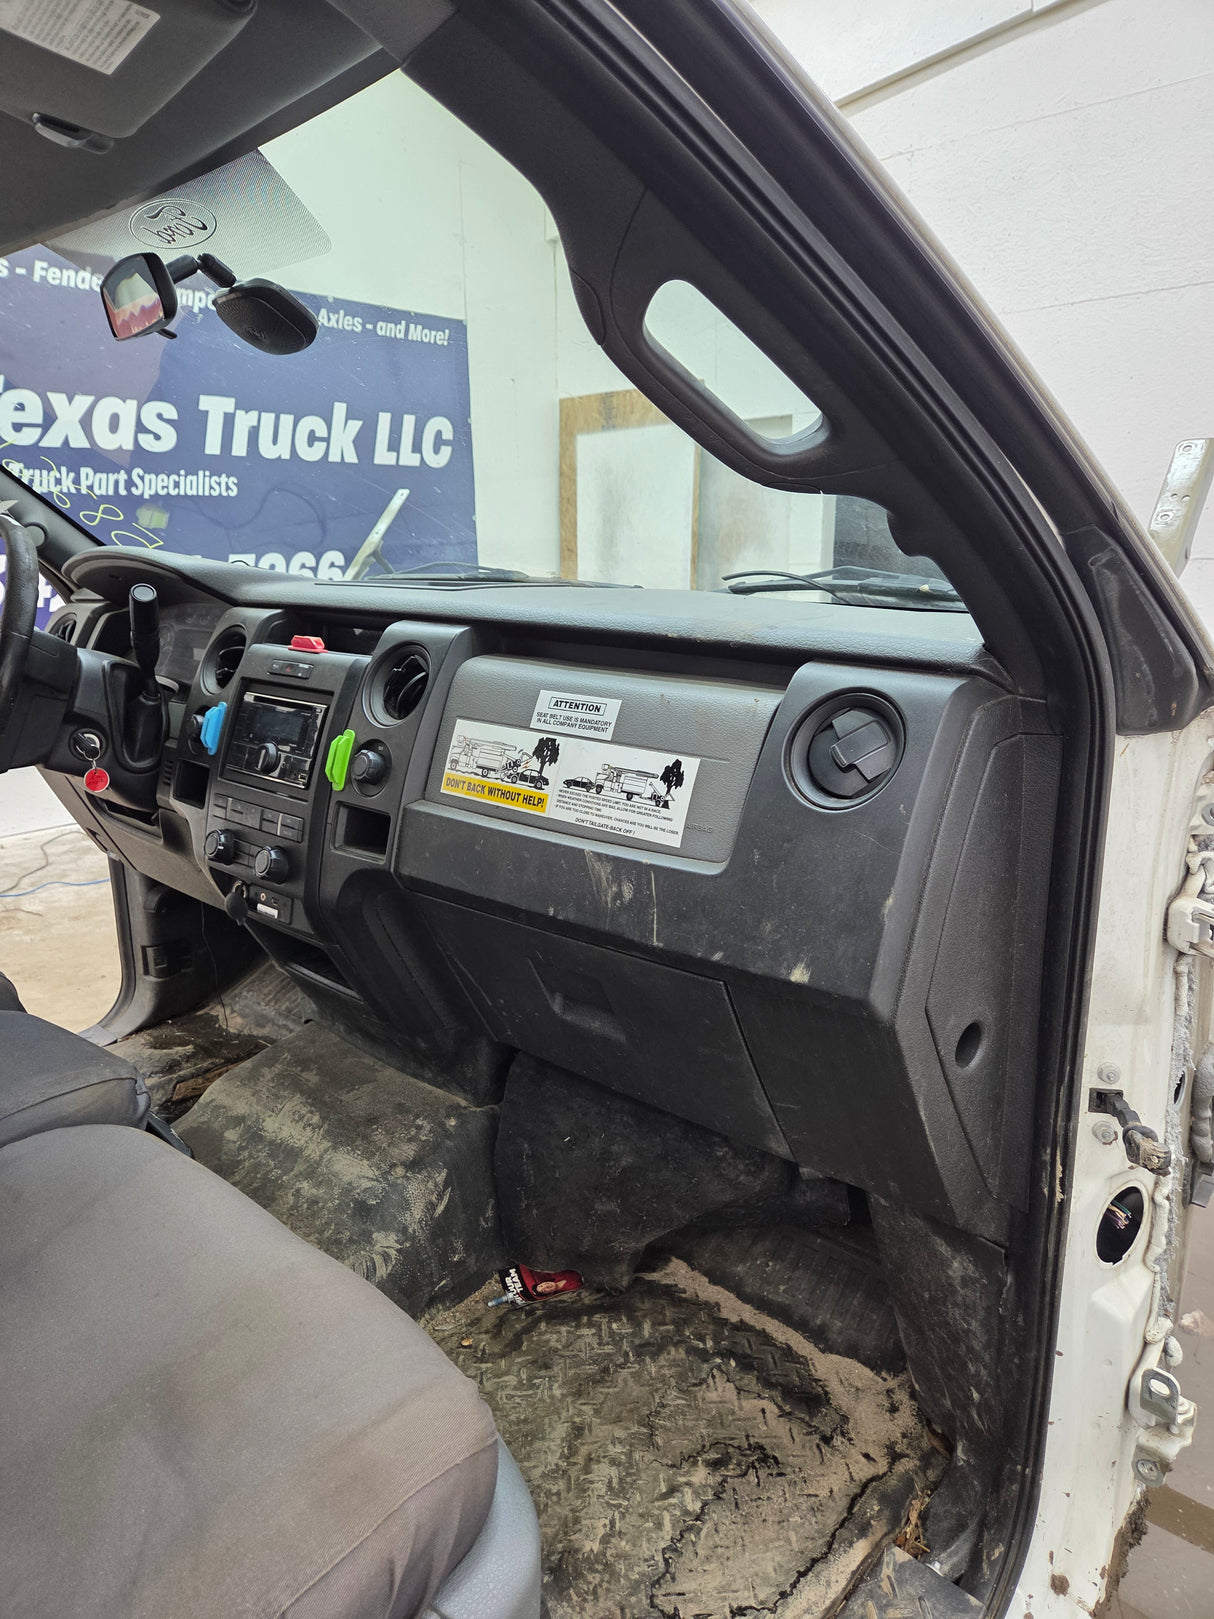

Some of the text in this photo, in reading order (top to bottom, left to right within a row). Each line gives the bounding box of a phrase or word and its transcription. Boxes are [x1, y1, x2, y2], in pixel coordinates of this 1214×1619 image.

[32, 259, 103, 292] Fende
[318, 308, 363, 333] Axles
[376, 320, 406, 340] and
[407, 323, 450, 346] More!
[0, 374, 453, 468] exas Truck LLC
[8, 462, 238, 499] Truck Part Specialists
[553, 700, 602, 713] ATTENTION
[536, 711, 549, 719] SEAT
[580, 717, 612, 727] MANDATORY
[552, 720, 577, 729] COMPANY
[577, 723, 609, 733] EQUIPMENT
[446, 777, 545, 808] DON'T BACK WITHOUT HELP!
[575, 817, 588, 825] DON'T
